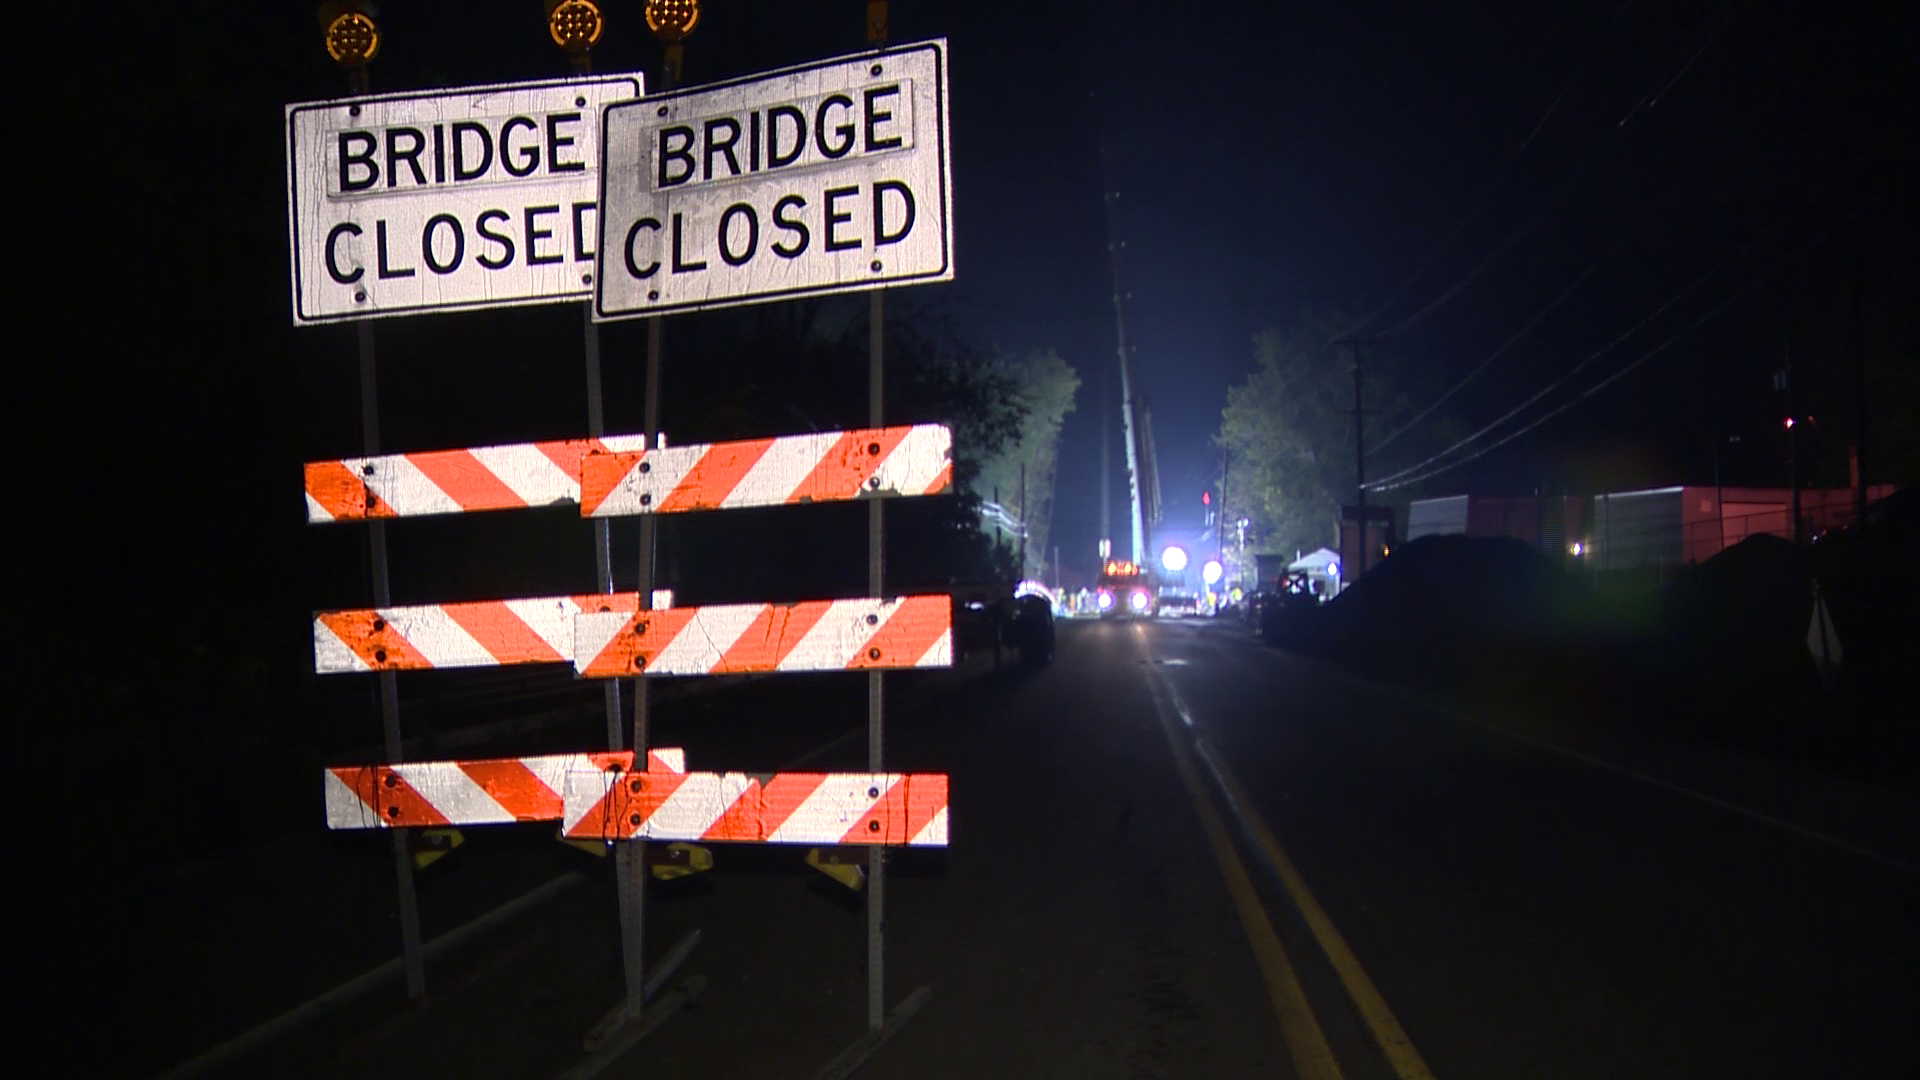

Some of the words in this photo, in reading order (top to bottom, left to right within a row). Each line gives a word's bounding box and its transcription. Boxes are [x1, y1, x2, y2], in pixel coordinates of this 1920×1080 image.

[338, 112, 586, 192] BRIDGE
[657, 84, 903, 189] BRIDGE
[624, 180, 916, 280] CLOSED
